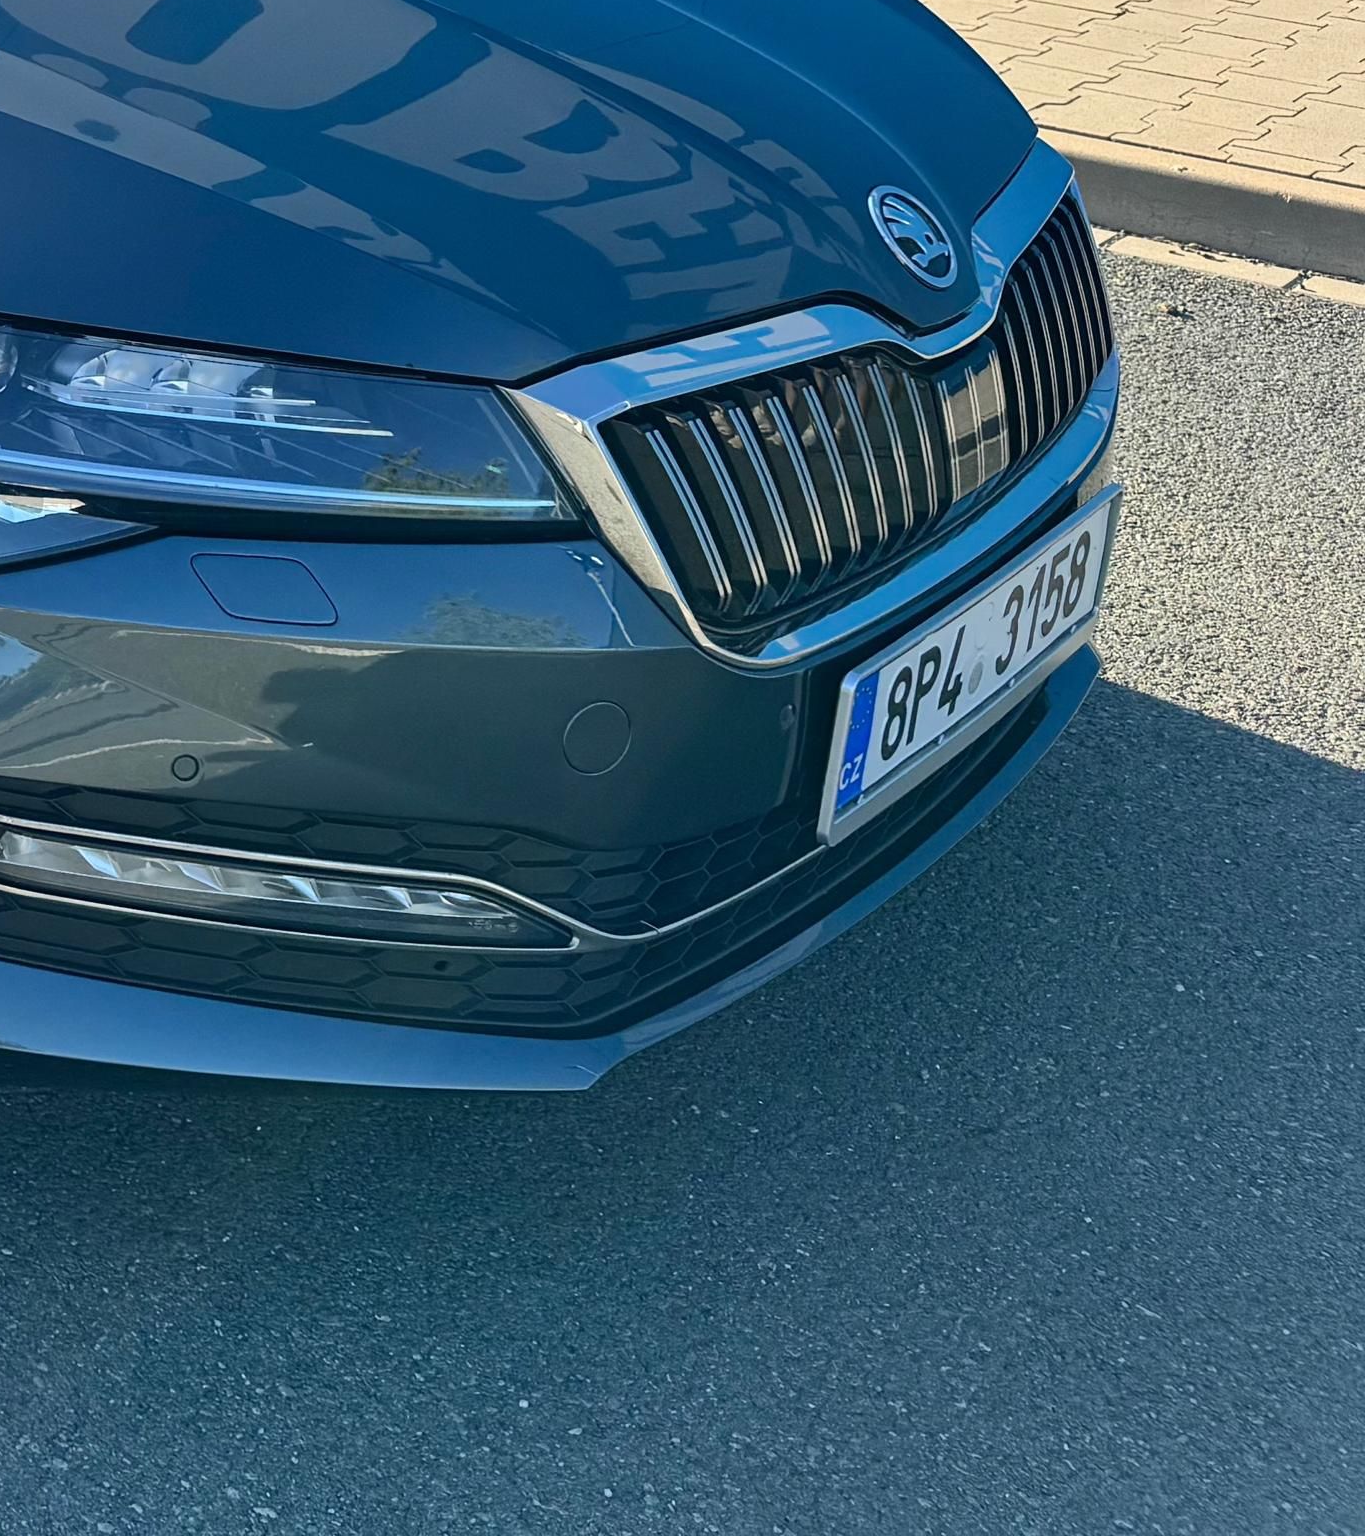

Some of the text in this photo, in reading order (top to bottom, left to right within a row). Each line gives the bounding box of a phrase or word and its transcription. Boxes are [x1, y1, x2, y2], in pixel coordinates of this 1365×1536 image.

[881, 530, 1092, 762] 8P4 3158
[839, 753, 864, 790] CZ
